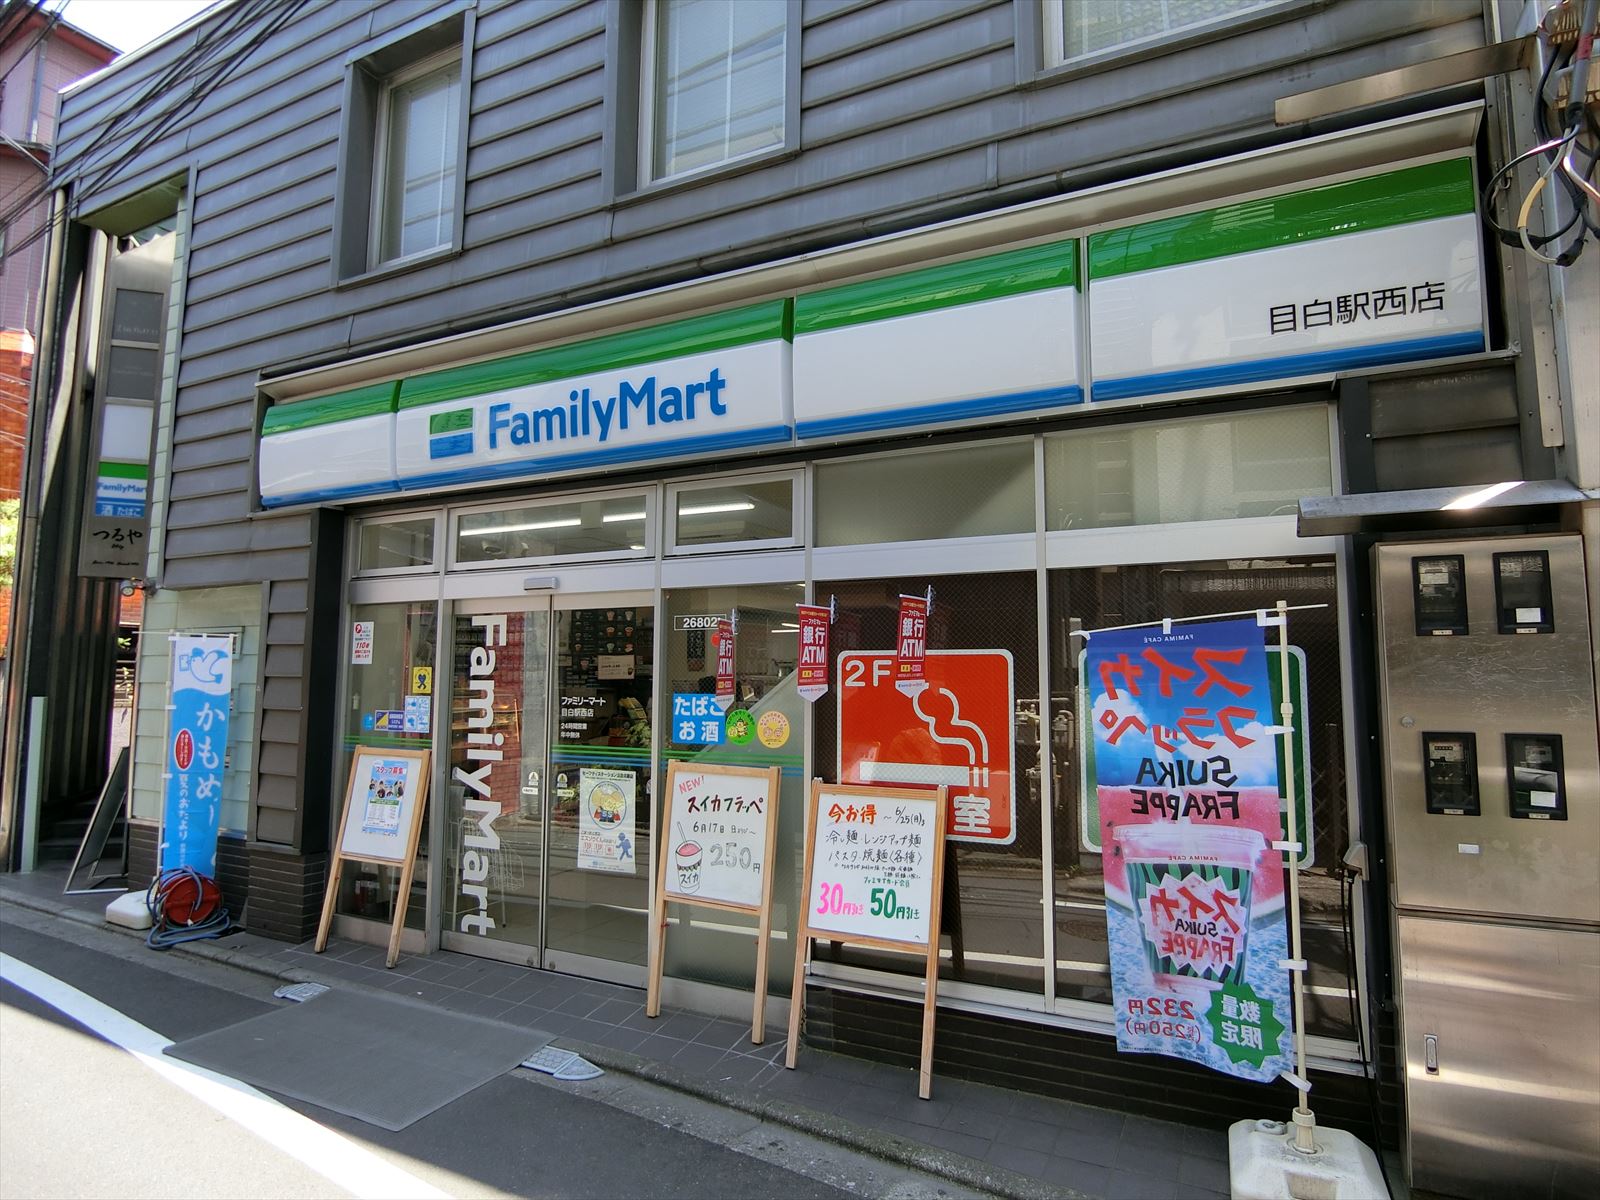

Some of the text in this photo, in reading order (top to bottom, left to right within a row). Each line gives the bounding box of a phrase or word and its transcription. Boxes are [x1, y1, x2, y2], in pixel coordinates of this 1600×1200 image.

[1269, 281, 1446, 334] 目白駅西店
[489, 367, 727, 449] FamilyMart
[92, 527, 143, 545] つるや
[683, 616, 718, 628] 26802
[902, 617, 924, 638] 銀行
[803, 625, 826, 645] 銀行
[719, 639, 733, 657] 銀行
[801, 645, 825, 664] ATM
[900, 639, 924, 658] ATM
[718, 658, 733, 675] ATM
[561, 696, 607, 707] ファミリーマート
[679, 721, 719, 743] お酒
[452, 614, 507, 937] FamilyMart
[678, 775, 705, 794] NEW!
[687, 794, 764, 814] スイカフラッペ
[827, 802, 878, 825] 今お得
[953, 793, 992, 834] 室
[680, 873, 699, 885] スイカ
